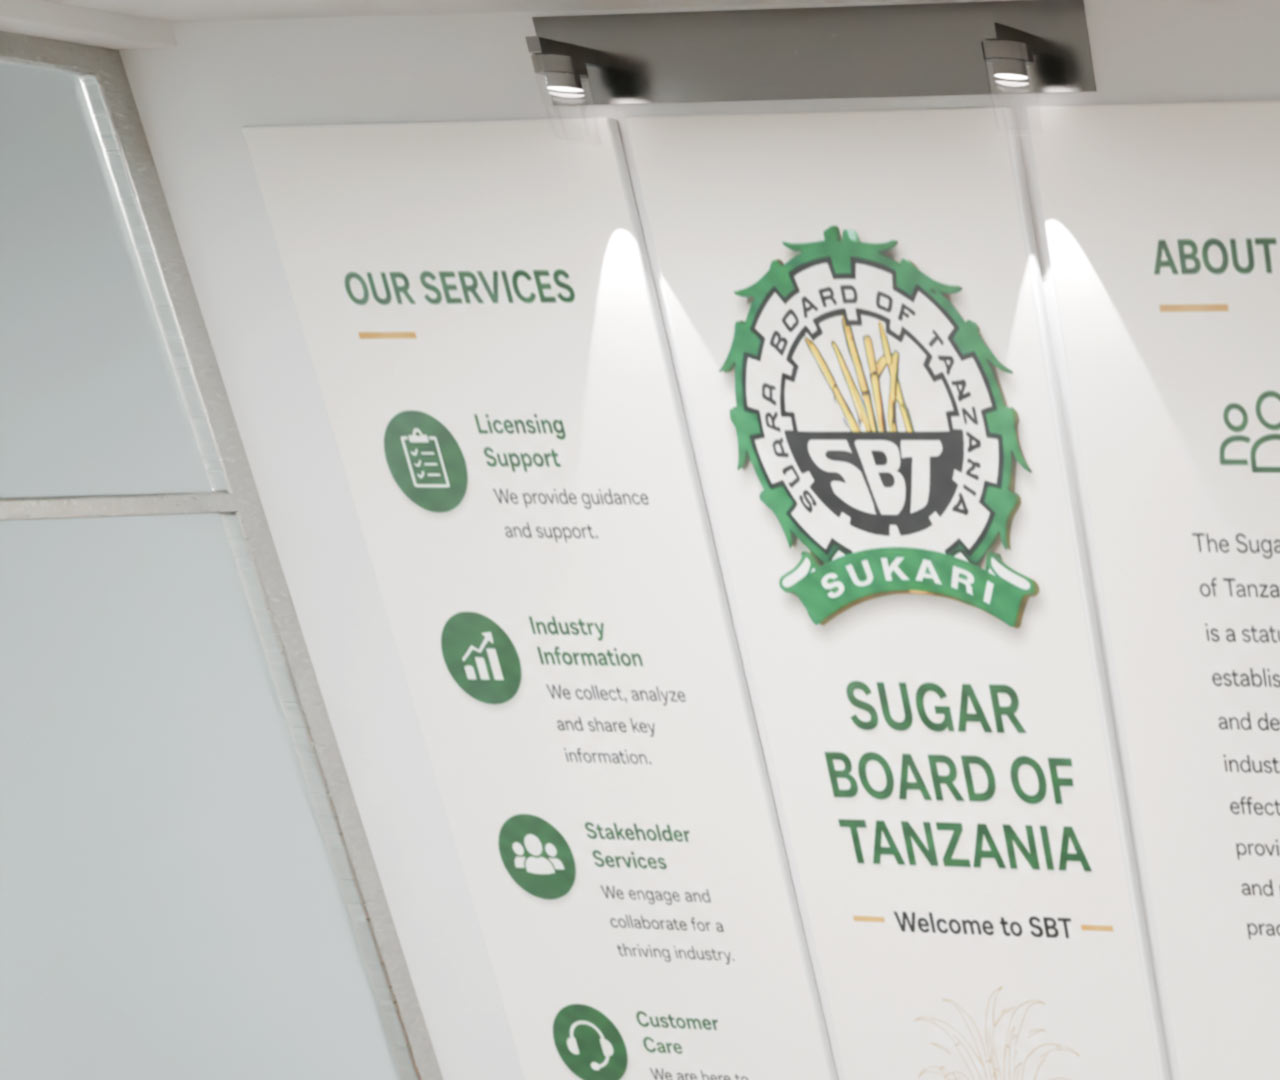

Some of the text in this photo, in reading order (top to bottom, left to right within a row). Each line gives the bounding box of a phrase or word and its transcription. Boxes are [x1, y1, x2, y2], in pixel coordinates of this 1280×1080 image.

[1155, 238, 1276, 274] ABOUT
[345, 269, 575, 305] OUR SERVICES
[770, 284, 858, 355] BOARD
[876, 291, 916, 321] OF
[928, 330, 982, 517] TANZANIA
[474, 414, 566, 440] Licensing
[484, 447, 560, 472] Support
[807, 438, 943, 516] SBT
[493, 488, 649, 510] We provide guidance
[504, 522, 598, 543] and support.
[1192, 533, 1230, 553] The
[820, 556, 995, 605] SUKARI
[1199, 577, 1217, 597] of
[529, 616, 604, 641] Industry
[1205, 624, 1220, 642] is
[1226, 628, 1236, 642] a
[537, 646, 643, 666] Information
[546, 684, 686, 706] We collect, analyze
[847, 681, 1025, 733] SUGAR
[557, 717, 655, 737] and share key
[1218, 712, 1252, 731] and
[564, 748, 652, 765] information.
[825, 752, 1073, 804] BOARD OF
[584, 822, 689, 842] Stakeholder
[839, 820, 1091, 872] TANZANIA
[592, 850, 667, 870] Services
[600, 885, 711, 905] We engage and
[1241, 879, 1274, 897] and
[610, 915, 724, 933] collaborate for a
[894, 912, 1071, 938] Welcome to SBT
[617, 943, 735, 965] thriving industry.
[636, 1011, 718, 1030] Customer
[643, 1037, 682, 1054] Care
